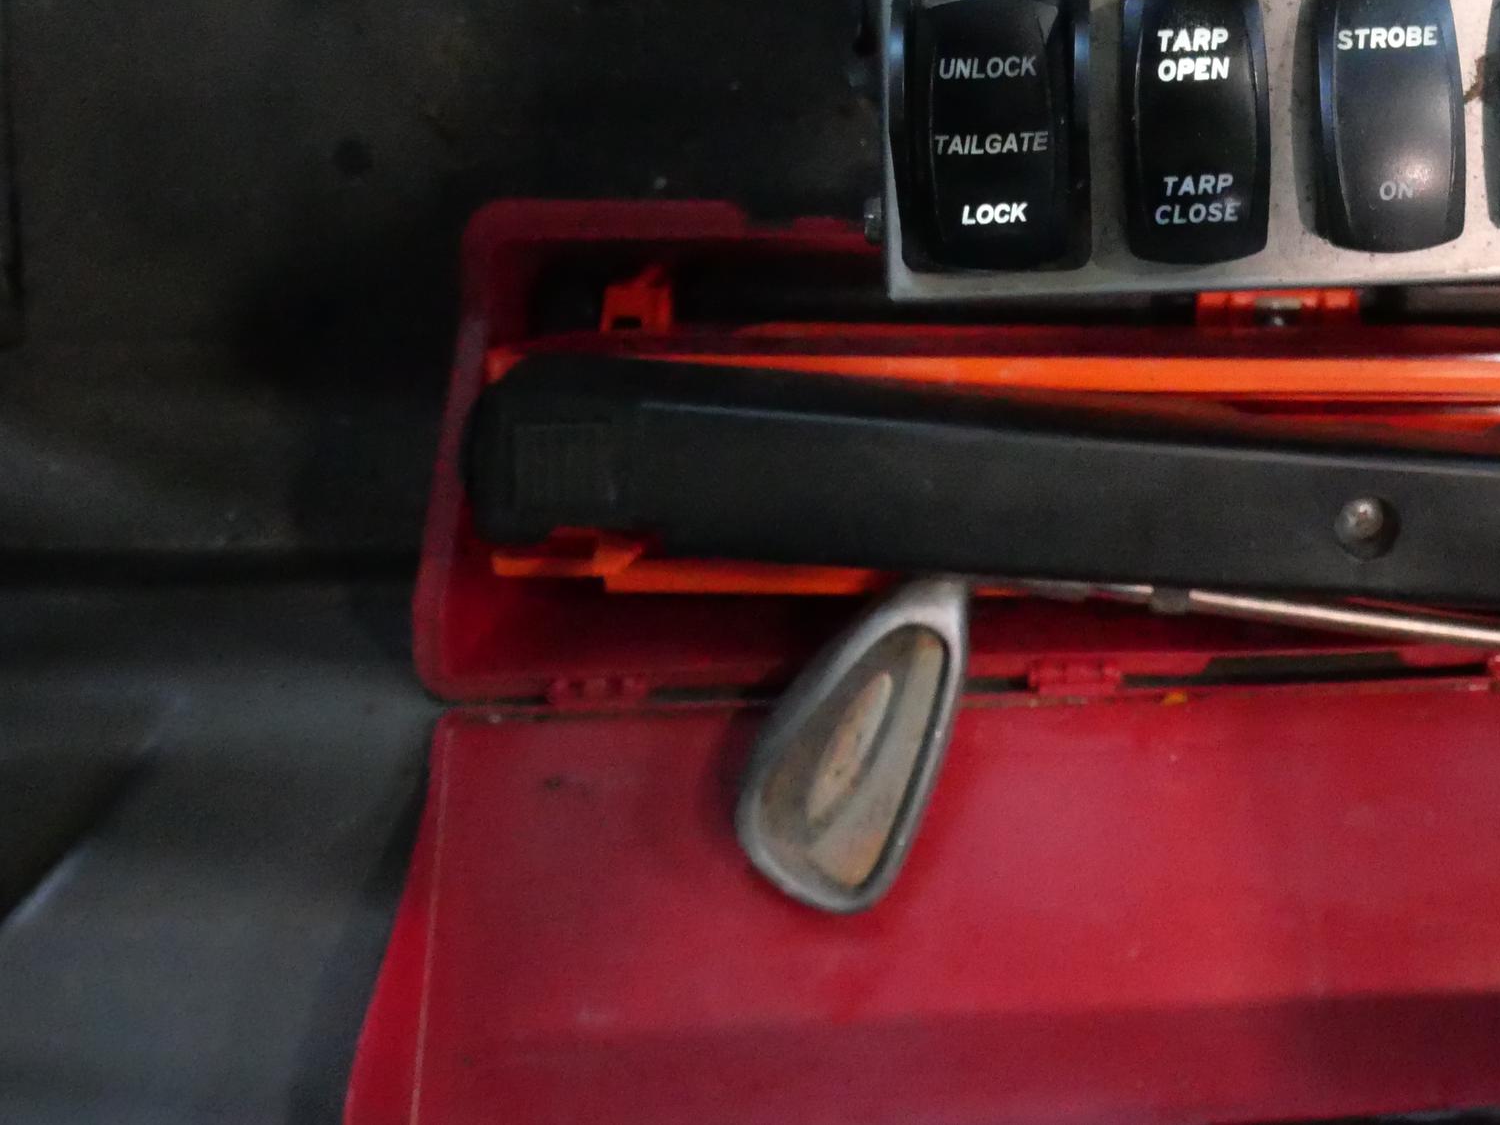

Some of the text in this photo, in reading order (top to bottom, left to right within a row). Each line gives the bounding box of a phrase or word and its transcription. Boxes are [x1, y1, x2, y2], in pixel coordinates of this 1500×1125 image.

[1157, 27, 1229, 53] TARP
[1337, 25, 1438, 51] STROBE
[938, 56, 1037, 80] UNLOCK
[1157, 56, 1230, 82] OPEN
[934, 131, 1049, 156] TAILGATE
[1163, 173, 1234, 196] TARP
[1379, 180, 1415, 202] ON
[961, 202, 1028, 226] LOCK
[1154, 200, 1241, 225] CLOSE
